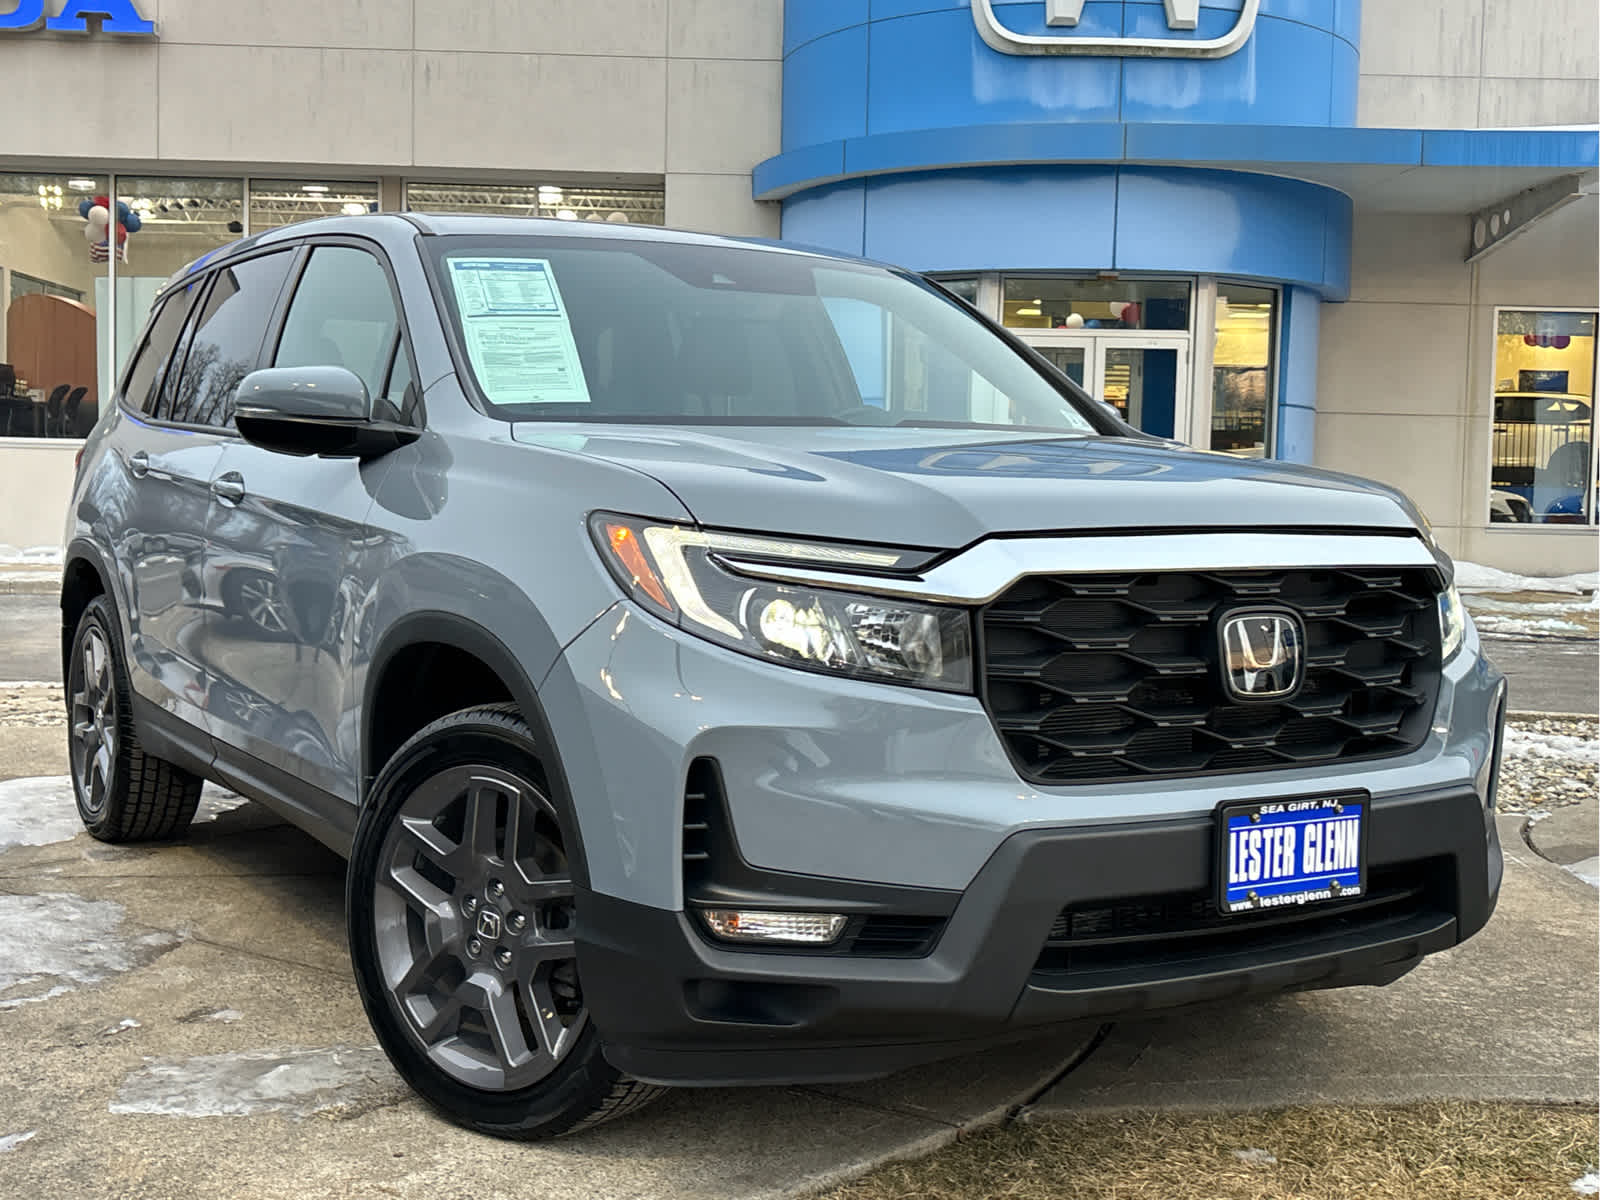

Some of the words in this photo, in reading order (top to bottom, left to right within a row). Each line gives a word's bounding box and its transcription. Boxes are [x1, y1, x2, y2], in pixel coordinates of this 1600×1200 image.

[1260, 805, 1285, 815] SEA
[1287, 801, 1320, 812] GIRT,
[1322, 799, 1339, 808] NJ
[1229, 826, 1296, 884] LESTER
[1302, 818, 1360, 874] GLENN
